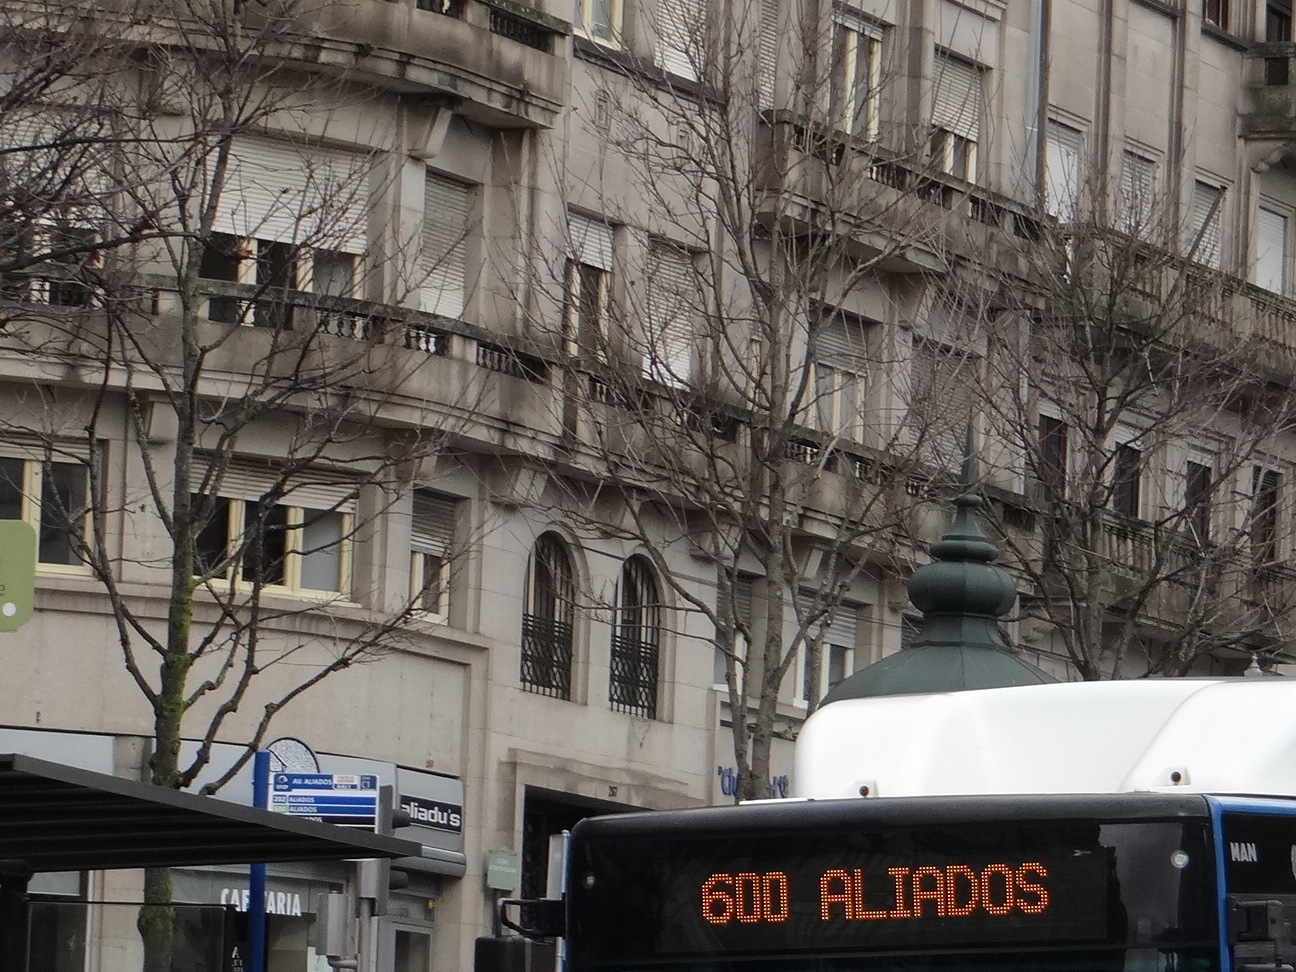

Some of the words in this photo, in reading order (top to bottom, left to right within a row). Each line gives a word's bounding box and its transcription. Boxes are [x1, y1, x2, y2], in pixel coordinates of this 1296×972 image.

[304, 778, 332, 786] ALIADOS
[289, 796, 315, 804] ALIADOS
[1230, 842, 1257, 862] MAN
[220, 887, 302, 917] CAFARIA
[701, 871, 789, 924] 600
[819, 862, 1050, 921] ALIADOS
